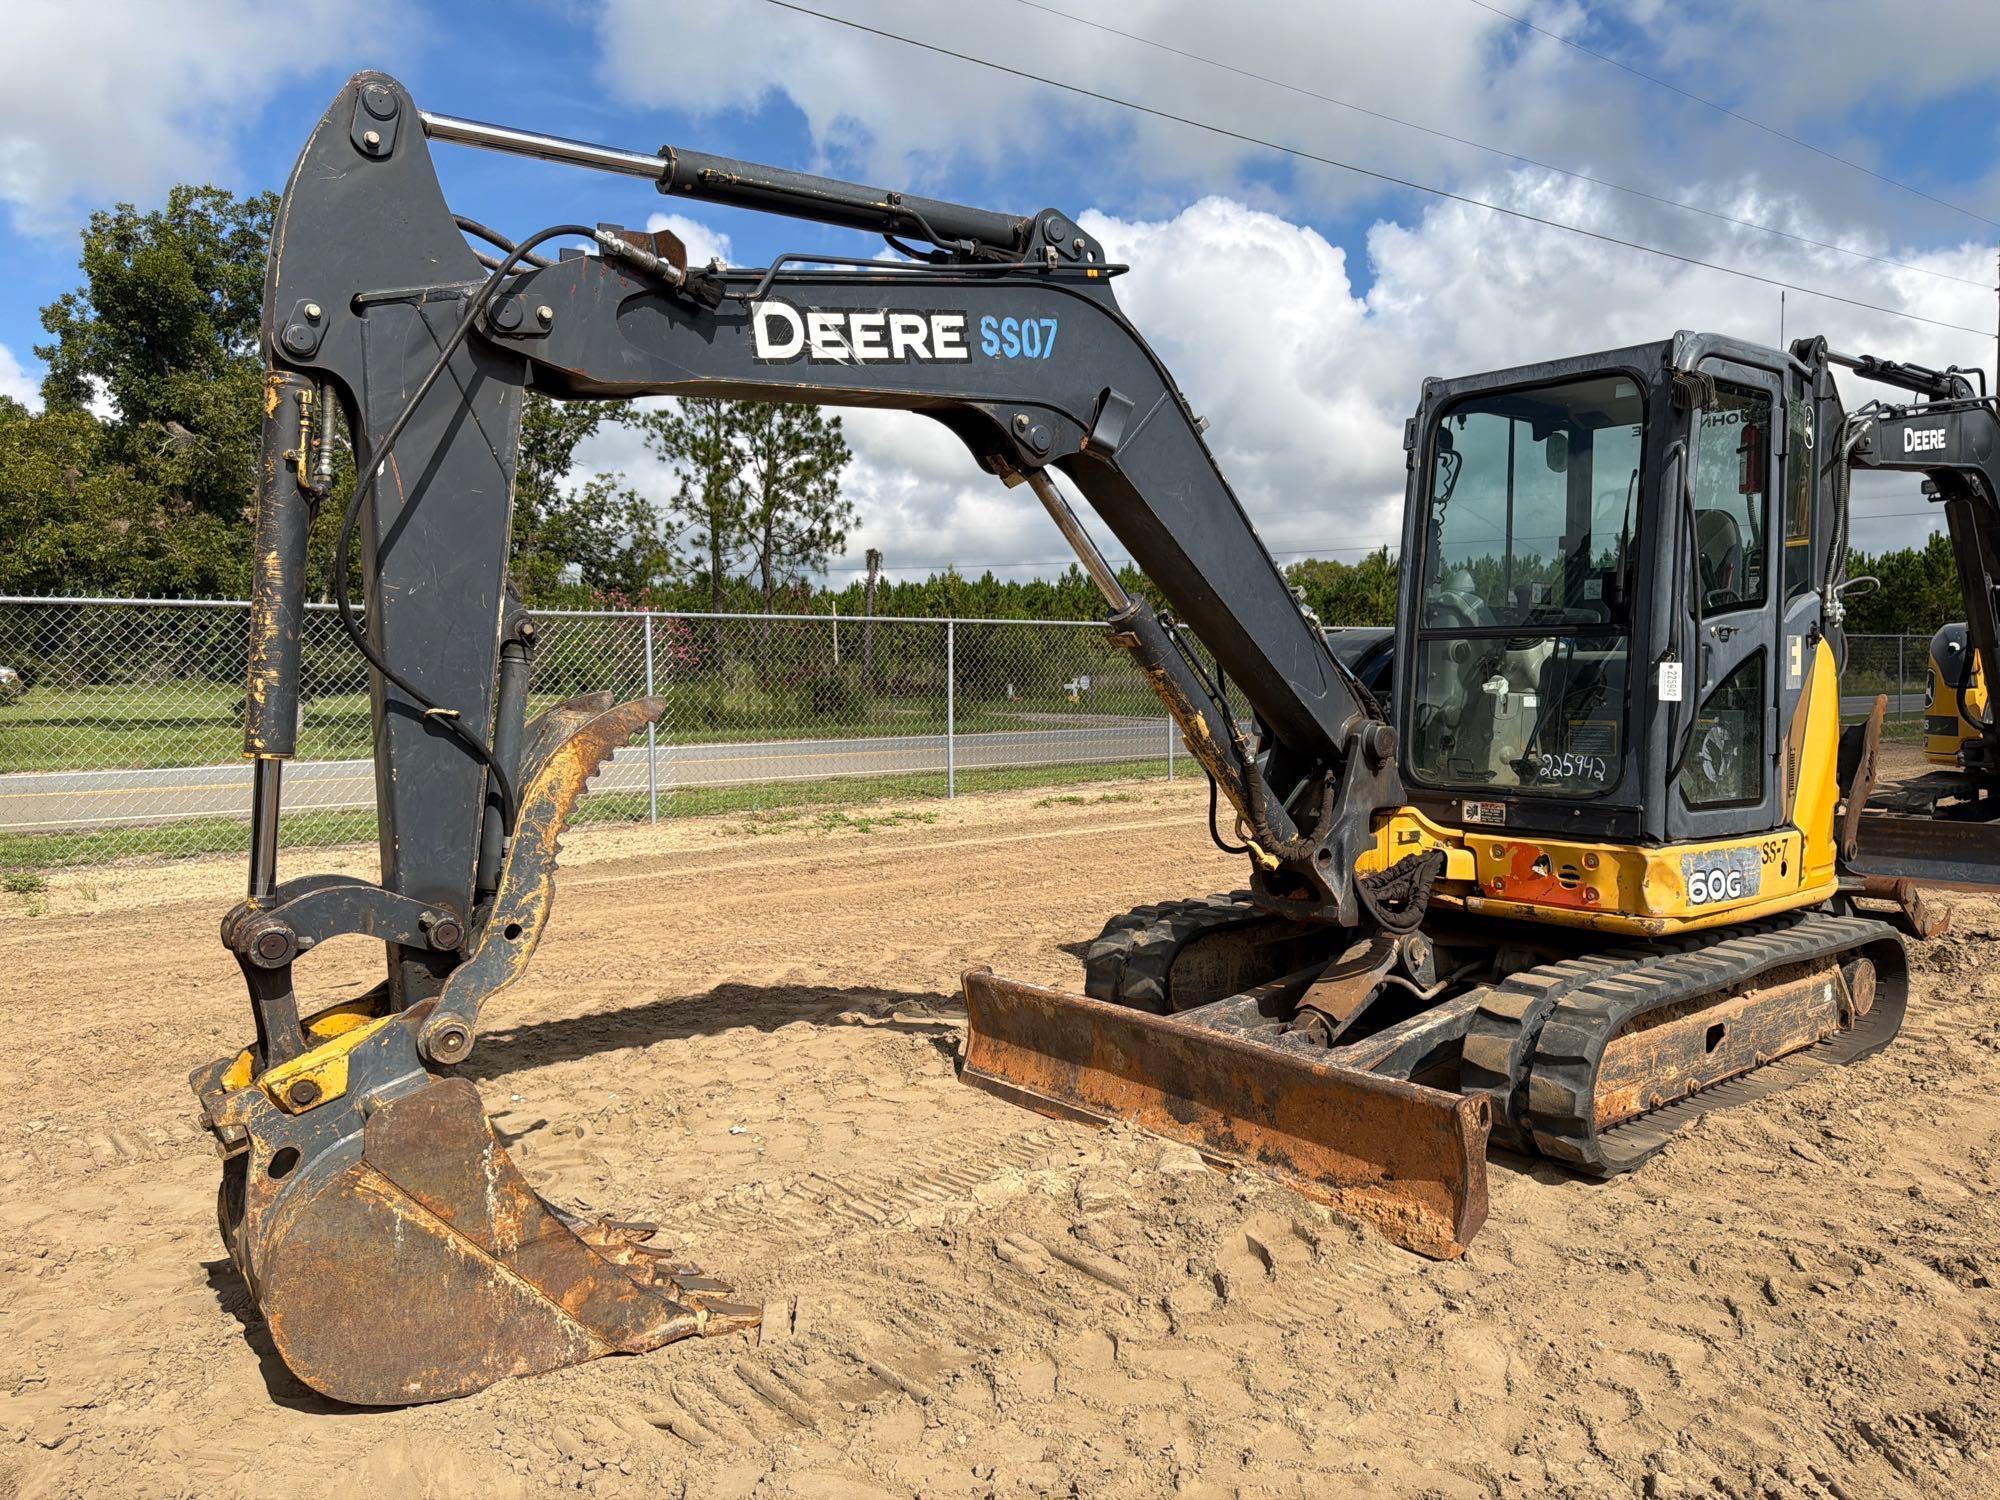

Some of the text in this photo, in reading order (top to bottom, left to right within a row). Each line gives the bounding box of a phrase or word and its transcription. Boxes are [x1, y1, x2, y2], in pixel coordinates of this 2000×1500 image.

[751, 300, 968, 360] DEERE
[980, 315, 1057, 359] SS07
[1903, 427, 1947, 453] DEERE
[1667, 671, 1677, 697] 225942
[1540, 753, 1606, 781] 225942
[1761, 838, 1789, 865] SS-7
[1688, 869, 1742, 904] 60G
